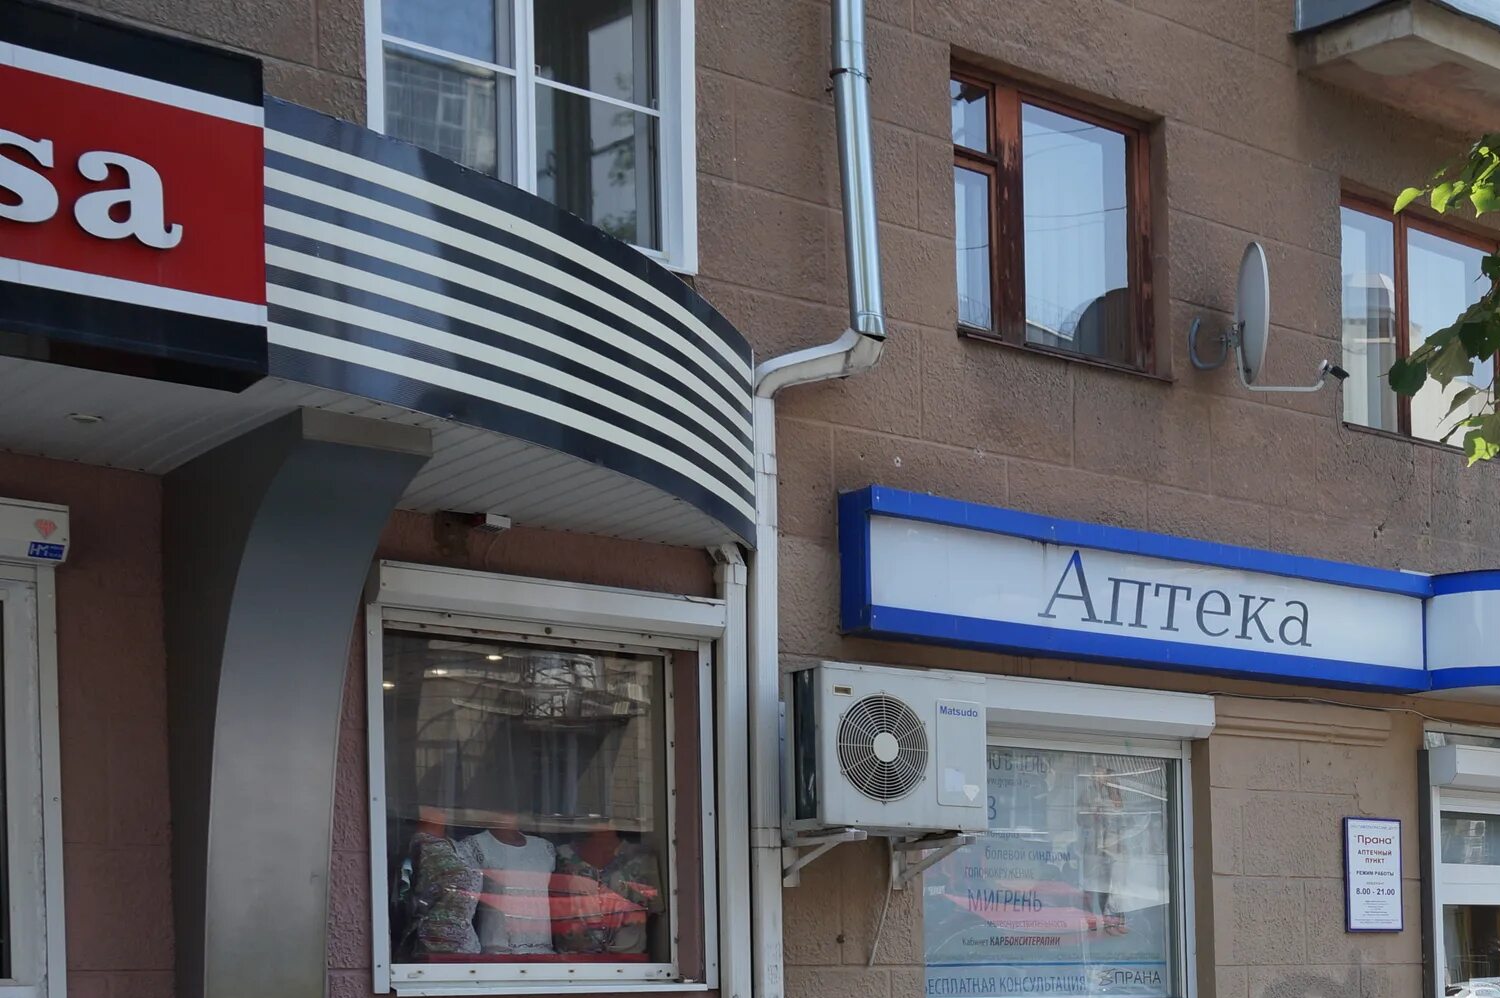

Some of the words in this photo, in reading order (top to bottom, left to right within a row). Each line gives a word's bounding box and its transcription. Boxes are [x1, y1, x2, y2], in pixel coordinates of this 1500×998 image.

[1037, 550, 1313, 648] Аптека
[939, 705, 978, 718] Matsudo
[1028, 848, 1071, 865] синдром
[1357, 849, 1393, 857] АПТЕЧНЫЙ
[1365, 857, 1386, 865] ПУНКТ
[1356, 887, 1371, 896] 8.00
[1376, 888, 1396, 896] 21.00
[967, 888, 1043, 913] МИГРЕНЬ
[989, 935, 1061, 947] КАРБОКСИТЕРАПИИ
[999, 975, 1087, 994] КОНСУЛЬТАЦИЯ
[1113, 969, 1162, 986] ПРАНА
